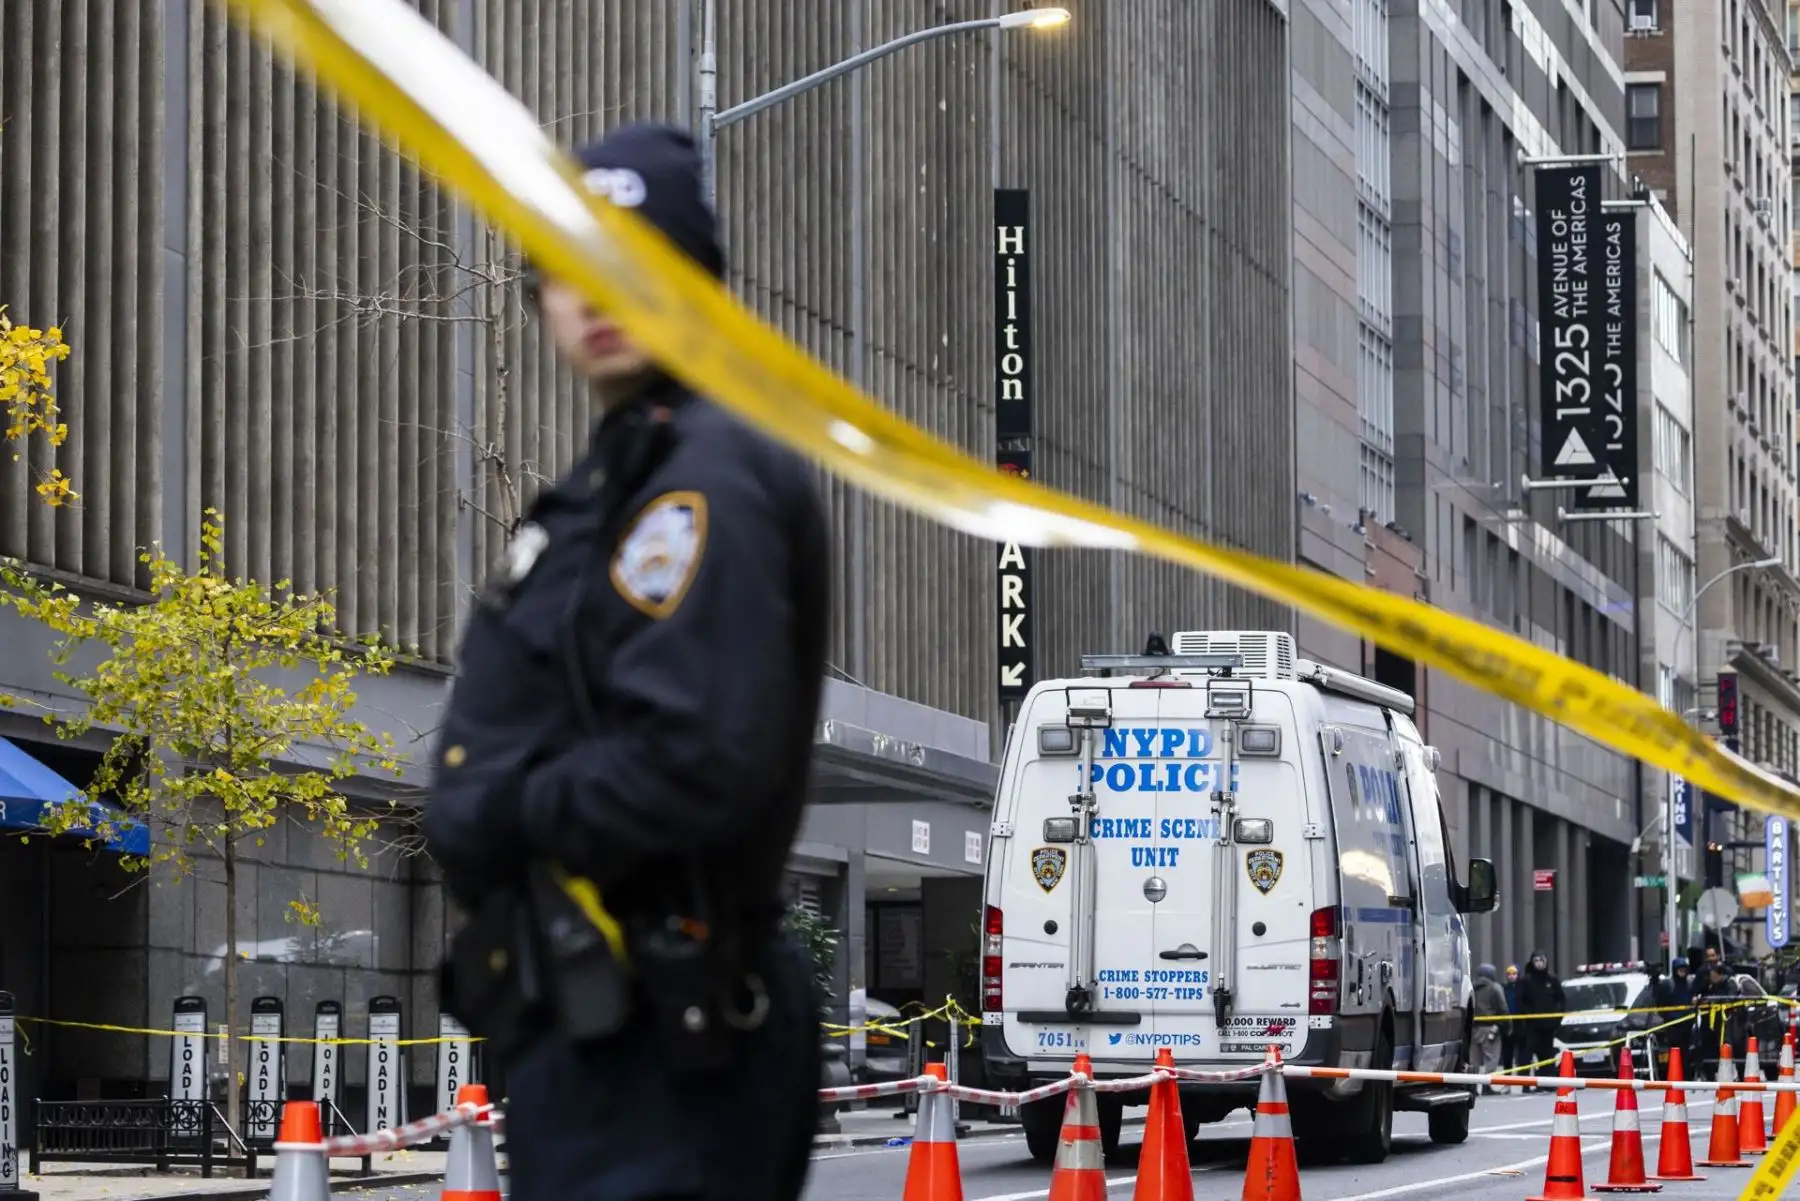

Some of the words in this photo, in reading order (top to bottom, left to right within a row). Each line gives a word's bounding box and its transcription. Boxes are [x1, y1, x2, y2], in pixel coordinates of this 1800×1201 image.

[1551, 209, 1568, 237] OF
[1570, 175, 1588, 274] AMERICAS
[1552, 241, 1569, 318] AVENUE
[1606, 222, 1621, 317] AMERICAS
[998, 225, 1025, 400] Hilton
[1572, 280, 1588, 318] THE
[1606, 322, 1621, 358] THE
[1555, 323, 1591, 421] 1325
[999, 540, 1026, 648] ARK
[1102, 728, 1214, 758] NYPD
[1077, 763, 1239, 792] POLICE
[1089, 818, 1152, 838] CRIME
[1160, 818, 1221, 839] SCENE
[1131, 847, 1180, 867] UNIT
[1772, 821, 1787, 940] BARTLEY'S
[1099, 970, 1139, 982] CRIME
[1144, 970, 1208, 983] STOPPERS
[1104, 987, 1203, 1000] 1-800-577-TIPS
[1225, 1017, 1253, 1026] 0,000
[1256, 1017, 1296, 1026] REWARD
[1038, 1032, 1072, 1047] 7051
[1125, 1034, 1201, 1046] @NYPDTIPS
